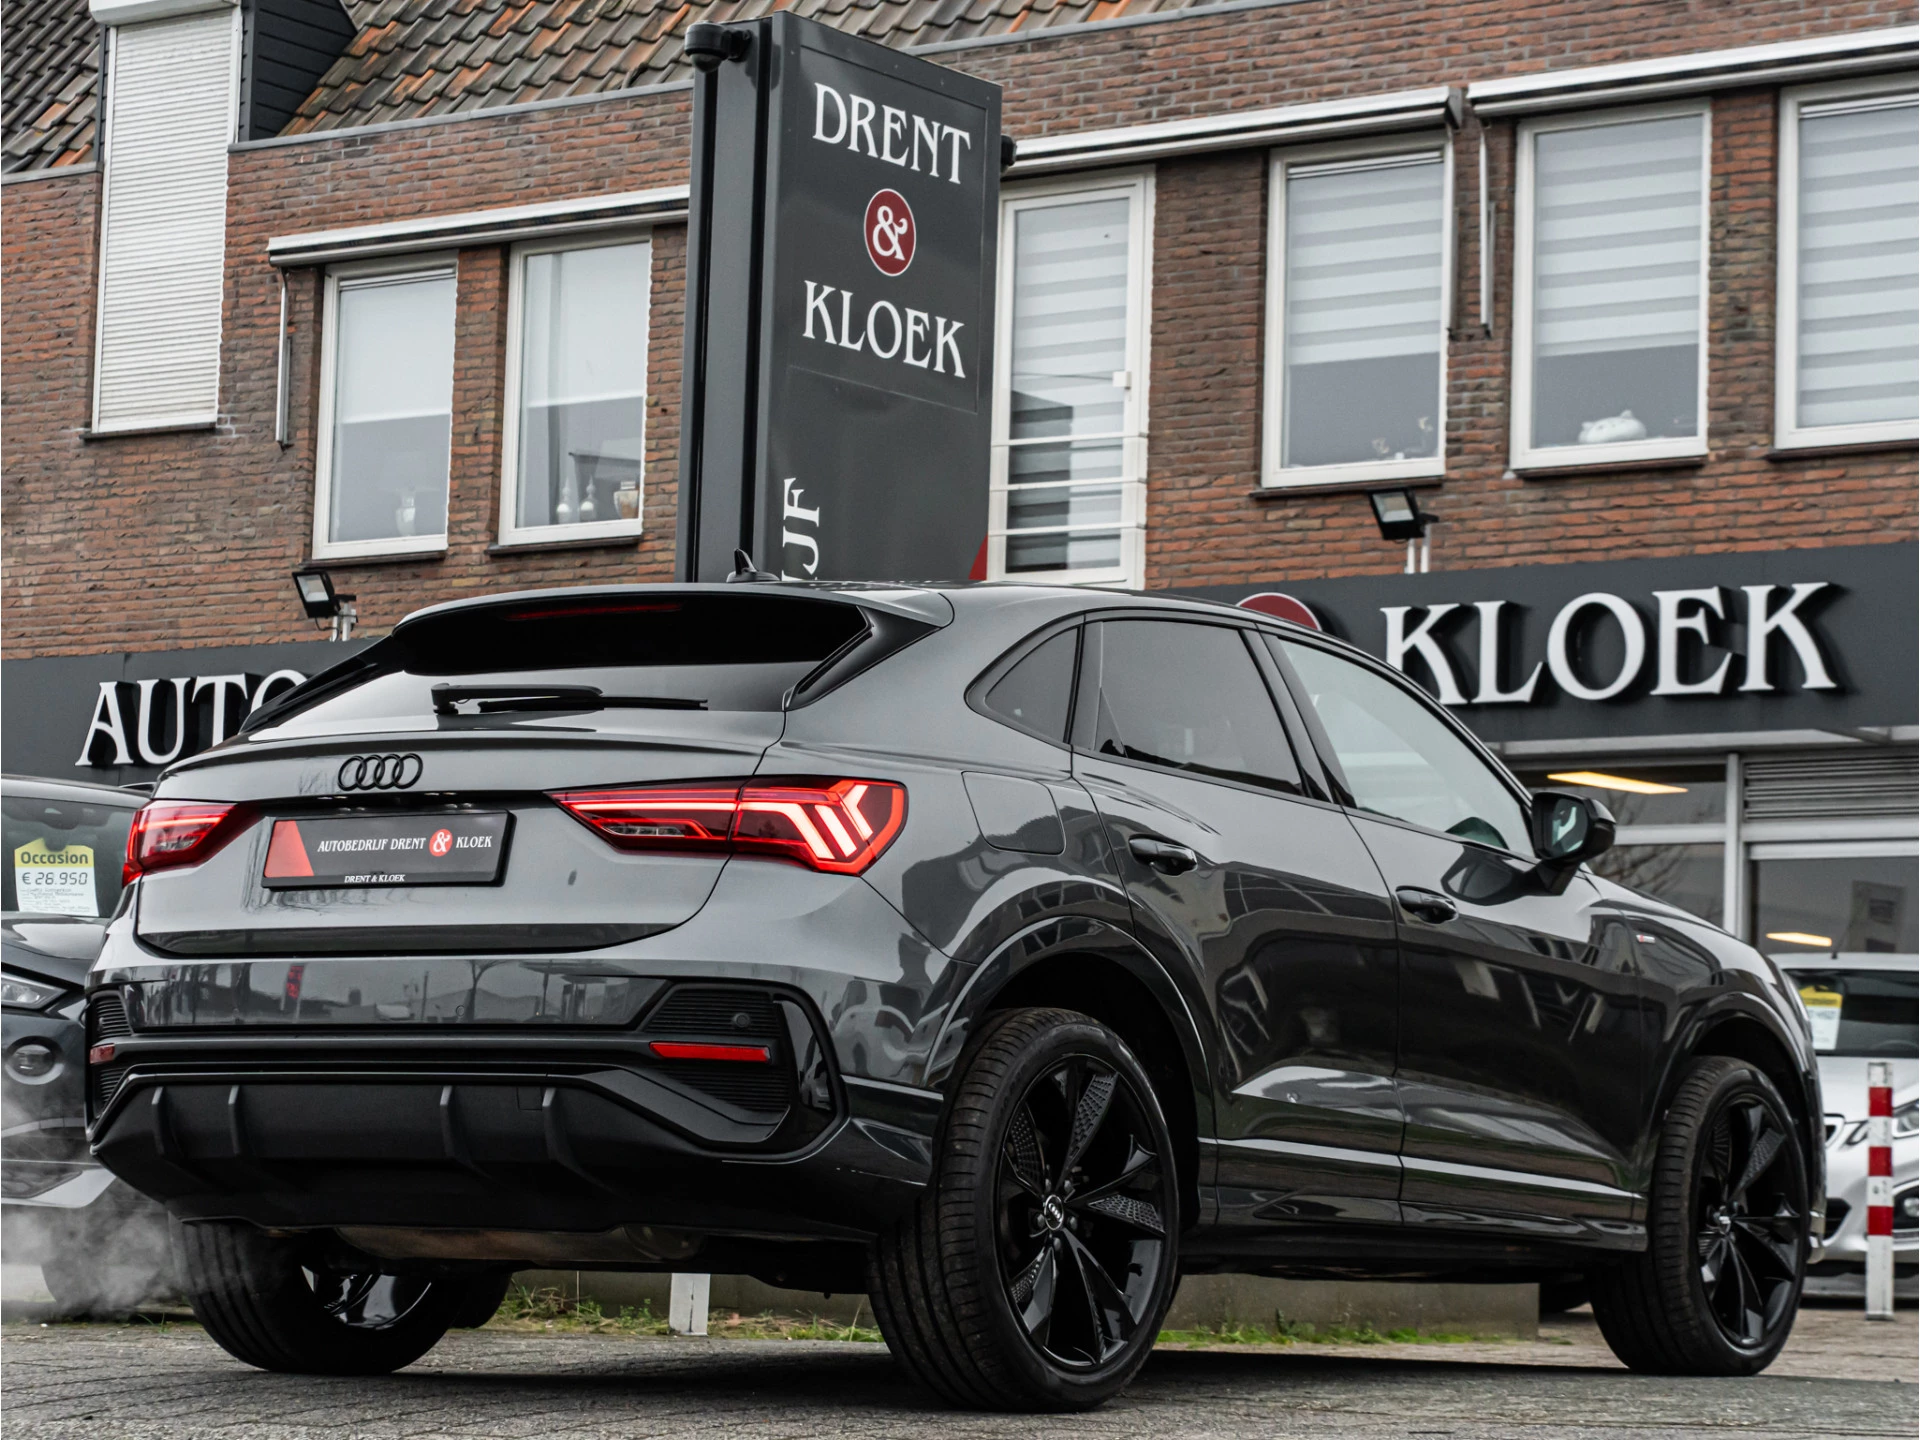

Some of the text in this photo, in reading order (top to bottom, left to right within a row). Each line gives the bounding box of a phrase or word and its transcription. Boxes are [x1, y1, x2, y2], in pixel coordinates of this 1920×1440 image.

[813, 82, 972, 185] DRENT
[873, 204, 908, 261] &
[802, 279, 967, 378] KLOEK
[1379, 582, 1838, 705] KLOEK
[20, 851, 89, 864] Occasion
[317, 832, 492, 852] AUTOBEDRIJF DRENT & KLOEK
[22, 871, 32, 885] €
[344, 875, 371, 883] DRENT
[379, 874, 406, 882] KLOEK
